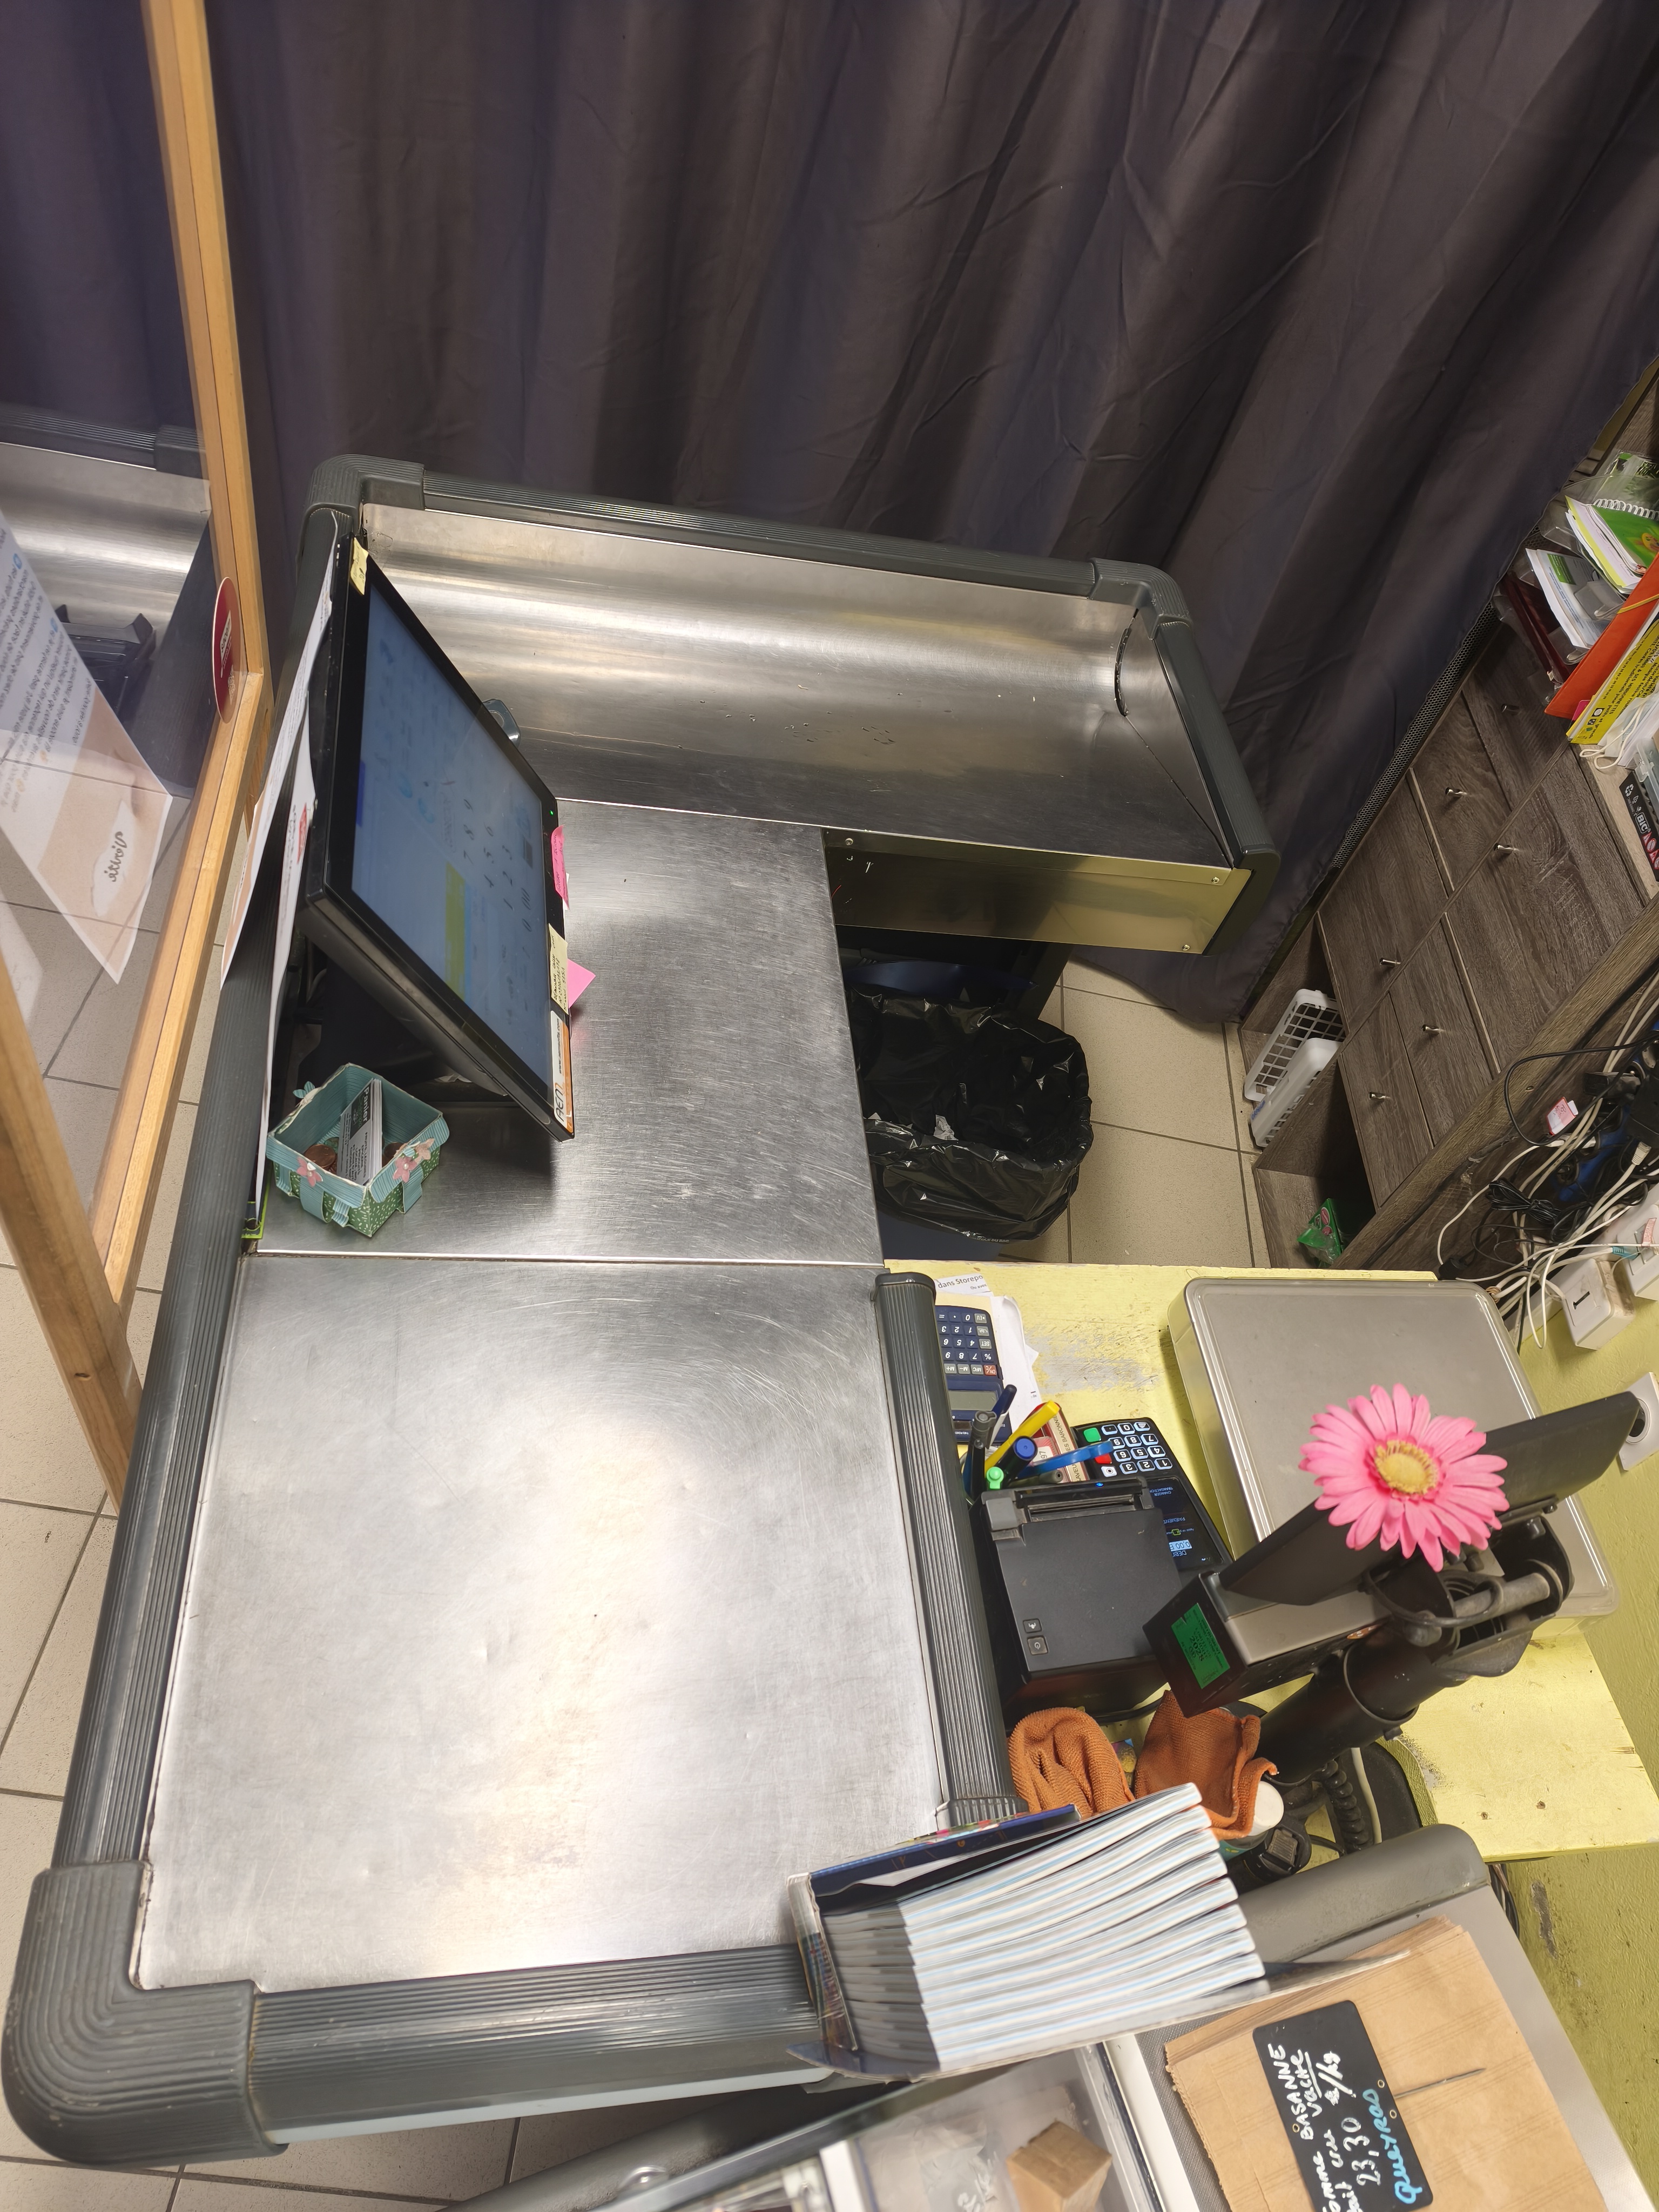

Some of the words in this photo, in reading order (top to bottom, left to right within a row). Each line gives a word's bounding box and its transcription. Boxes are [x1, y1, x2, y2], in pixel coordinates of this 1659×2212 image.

[1637, 814, 1648, 832] BIC
[1053, 1415, 1067, 1442] BARONNIE
[1190, 1636, 1204, 1661] 2028
[1267, 2044, 1313, 2140] BASANNE
[1341, 2117, 1381, 2186] 23,30
